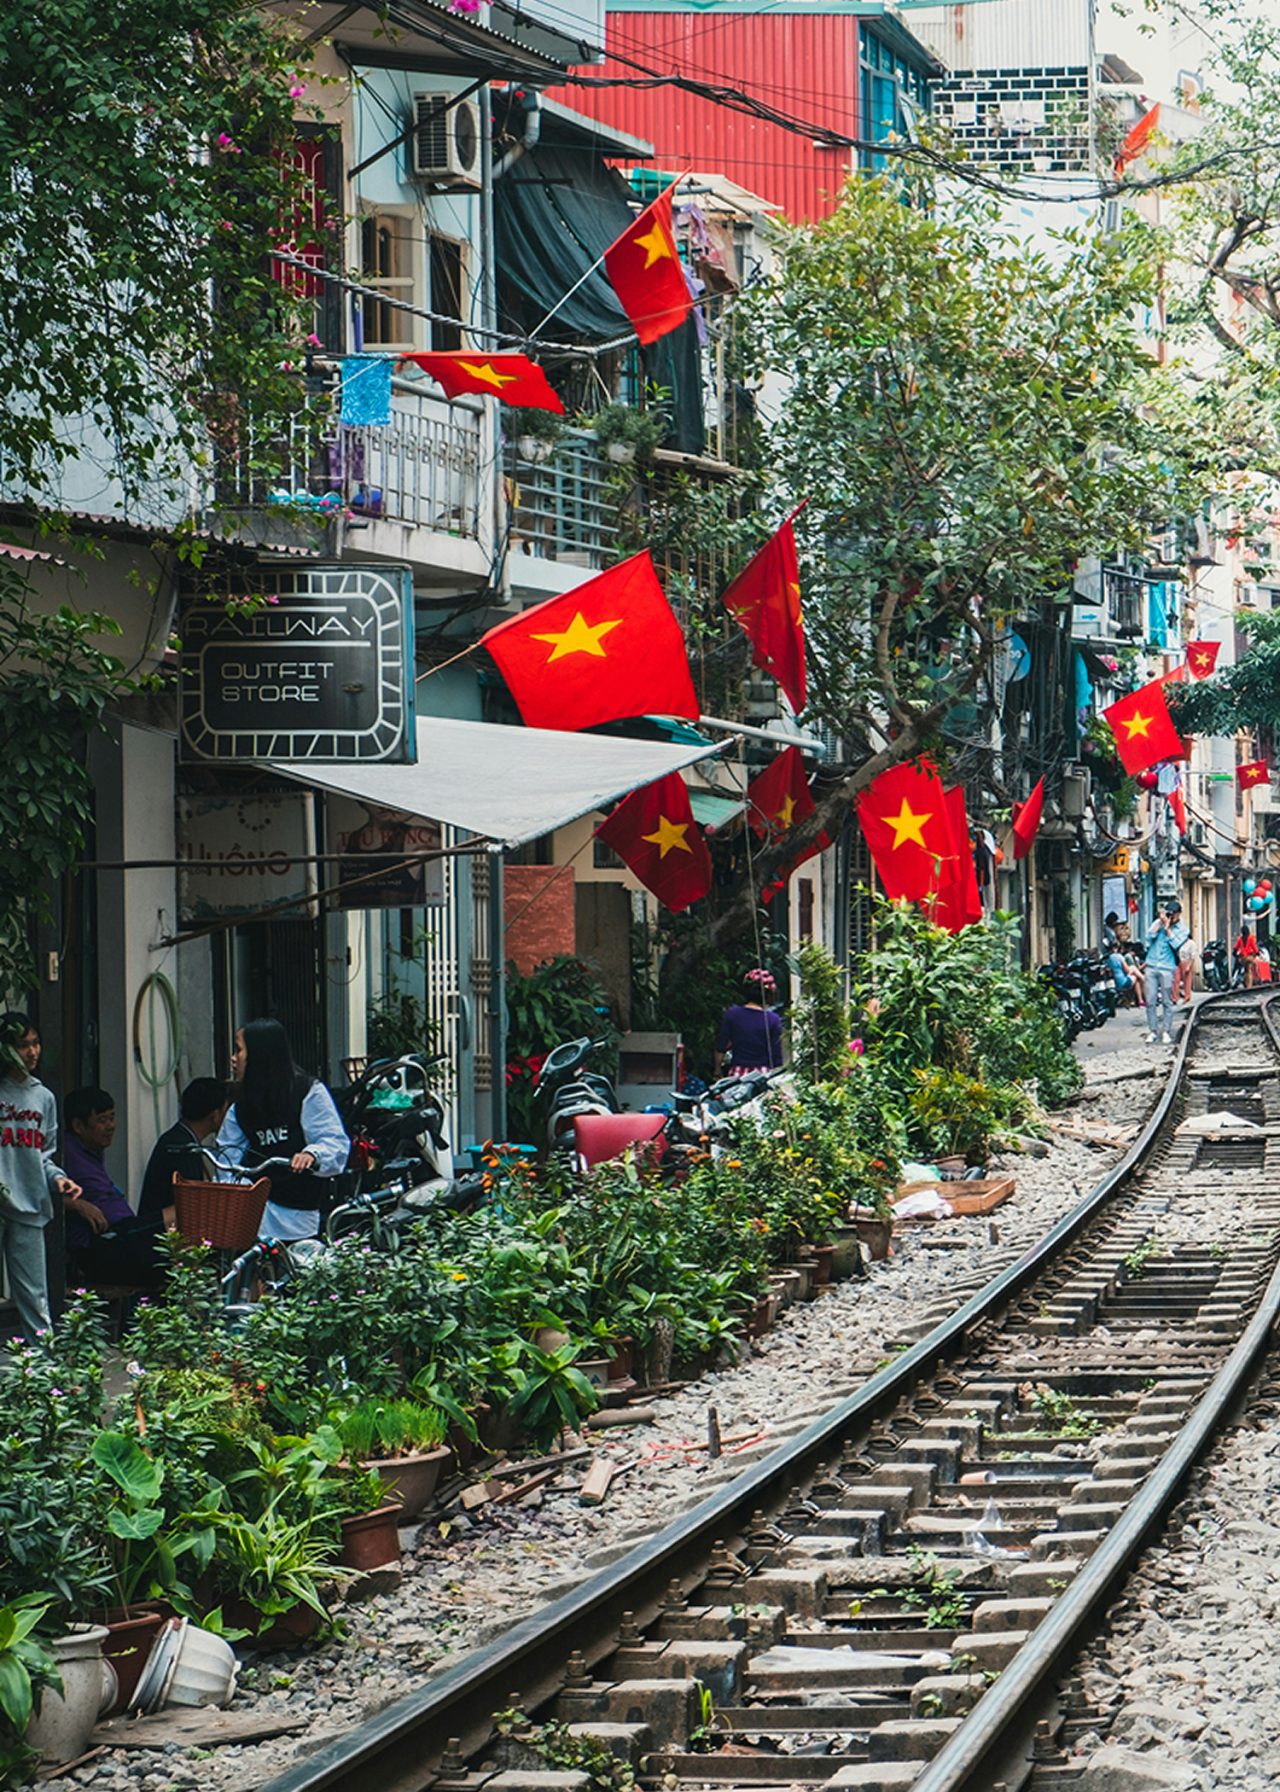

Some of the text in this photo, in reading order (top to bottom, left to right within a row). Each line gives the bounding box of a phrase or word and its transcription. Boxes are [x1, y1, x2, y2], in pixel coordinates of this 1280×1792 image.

[185, 615, 375, 637] RAILWAY
[220, 662, 335, 680] OUTFIT
[221, 684, 321, 702] STORE
[1112, 853, 1126, 866] 17
